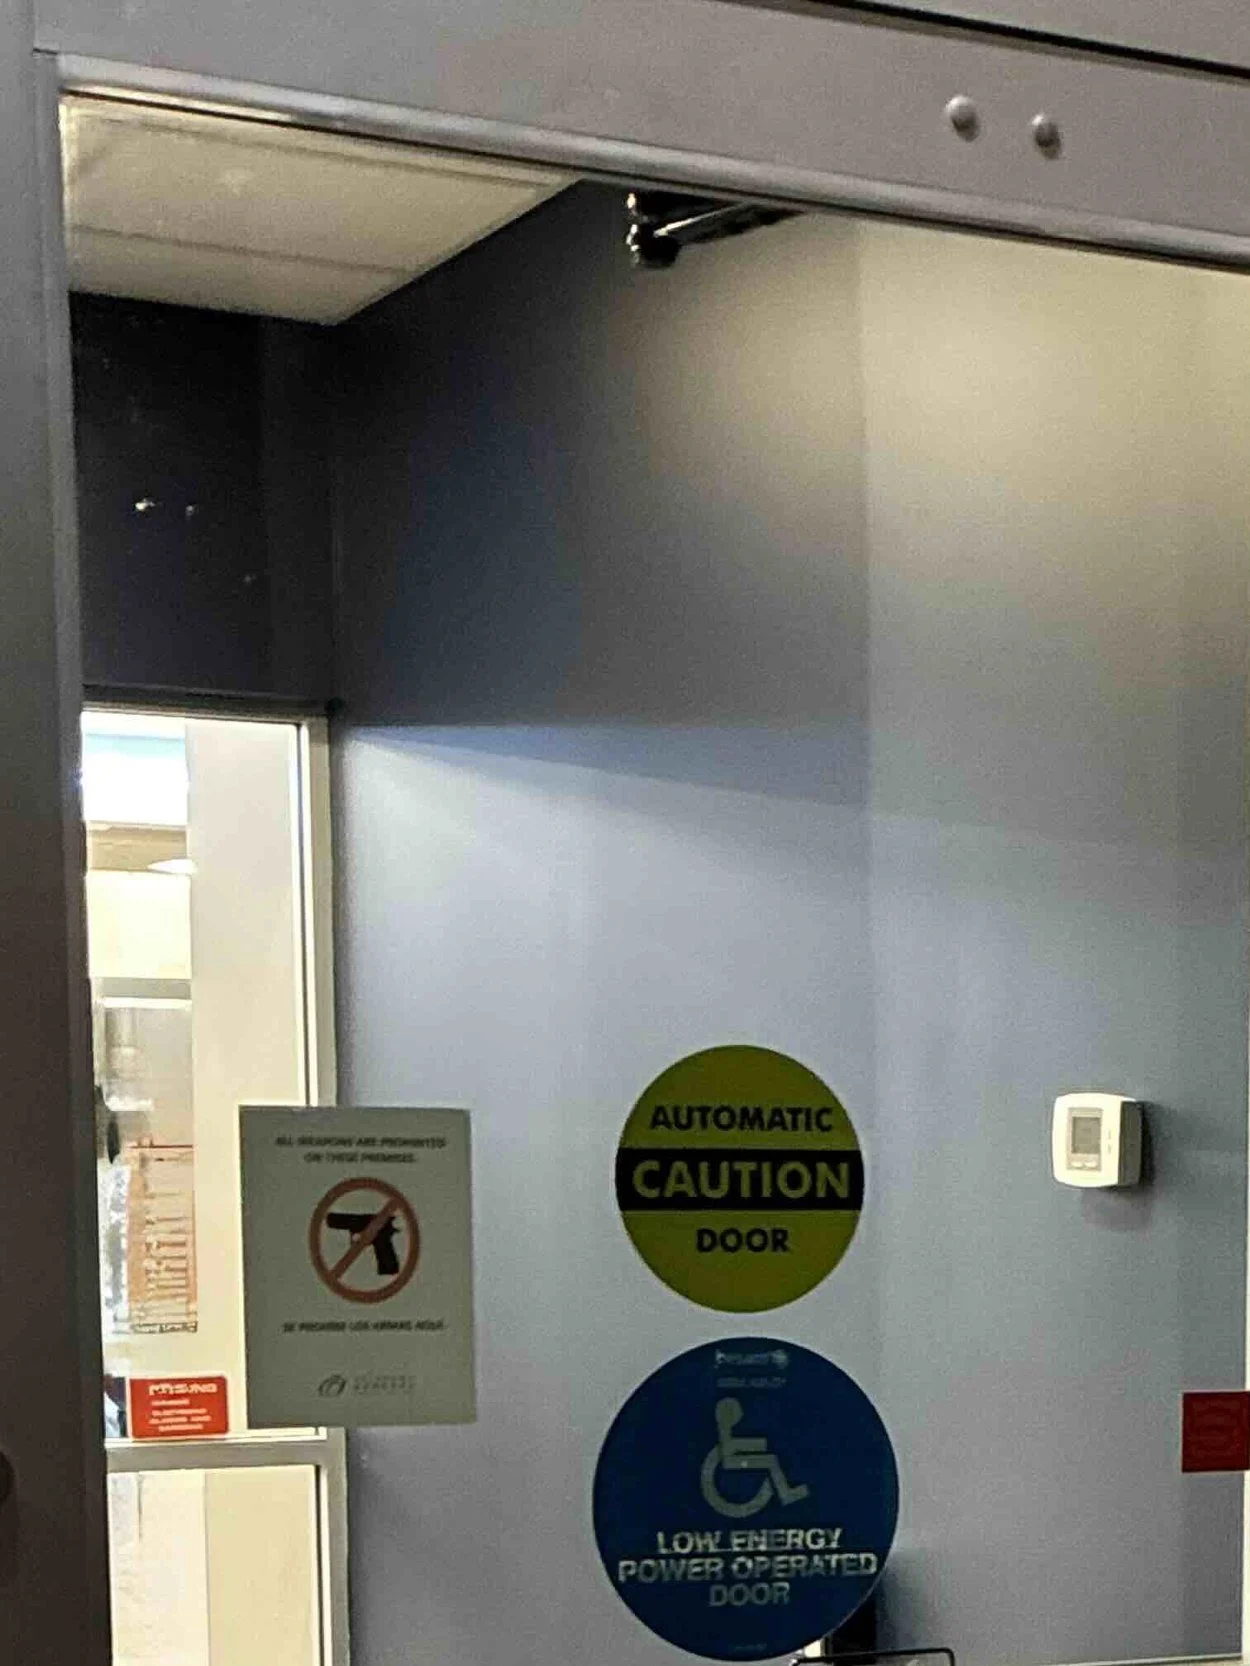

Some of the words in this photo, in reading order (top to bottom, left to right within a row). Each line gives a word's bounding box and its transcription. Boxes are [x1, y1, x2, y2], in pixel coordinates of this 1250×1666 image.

[650, 1105, 833, 1132] AUTOMATIC
[632, 1159, 851, 1200] CAUTION
[696, 1227, 790, 1255] DOOR
[655, 1531, 722, 1555] LOW
[730, 1527, 843, 1552] ENERGY
[618, 1557, 724, 1583] POWER
[731, 1553, 879, 1580] OPERATED
[709, 1582, 790, 1607] DOOR
